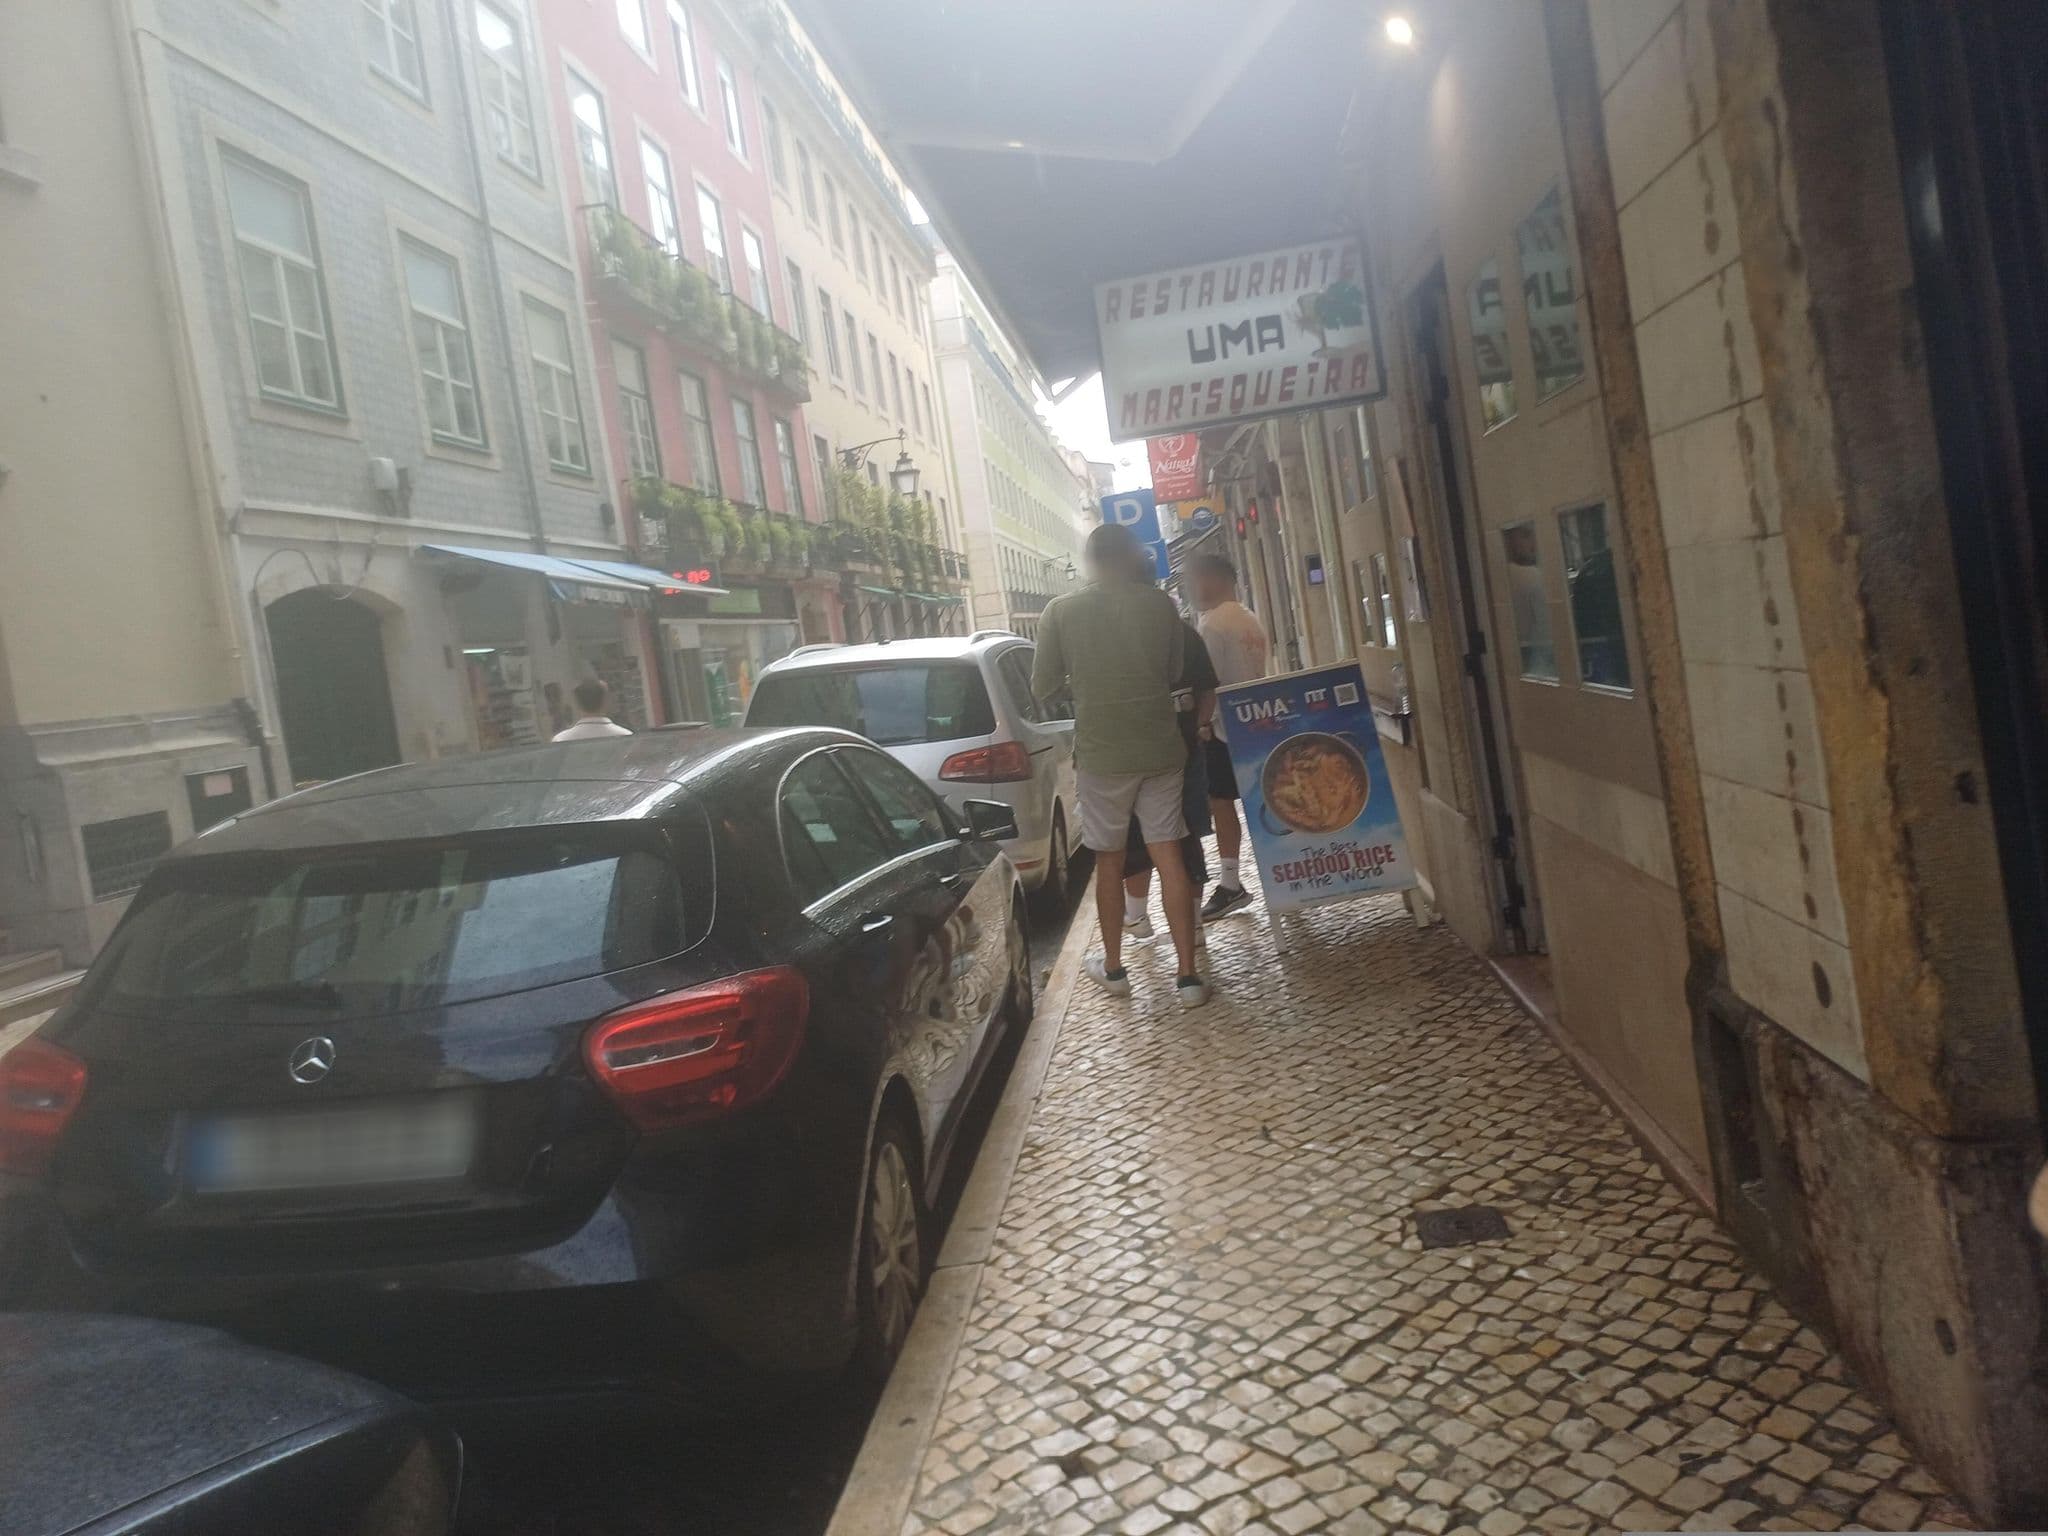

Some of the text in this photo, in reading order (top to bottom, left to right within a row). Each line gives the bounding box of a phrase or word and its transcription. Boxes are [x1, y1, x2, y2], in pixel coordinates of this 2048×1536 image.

[1105, 243, 1358, 324] RESTAURANTE
[1187, 314, 1285, 364] UMA
[1236, 698, 1289, 722] UMA
[1272, 844, 1396, 883] SEAFOOD RICE
